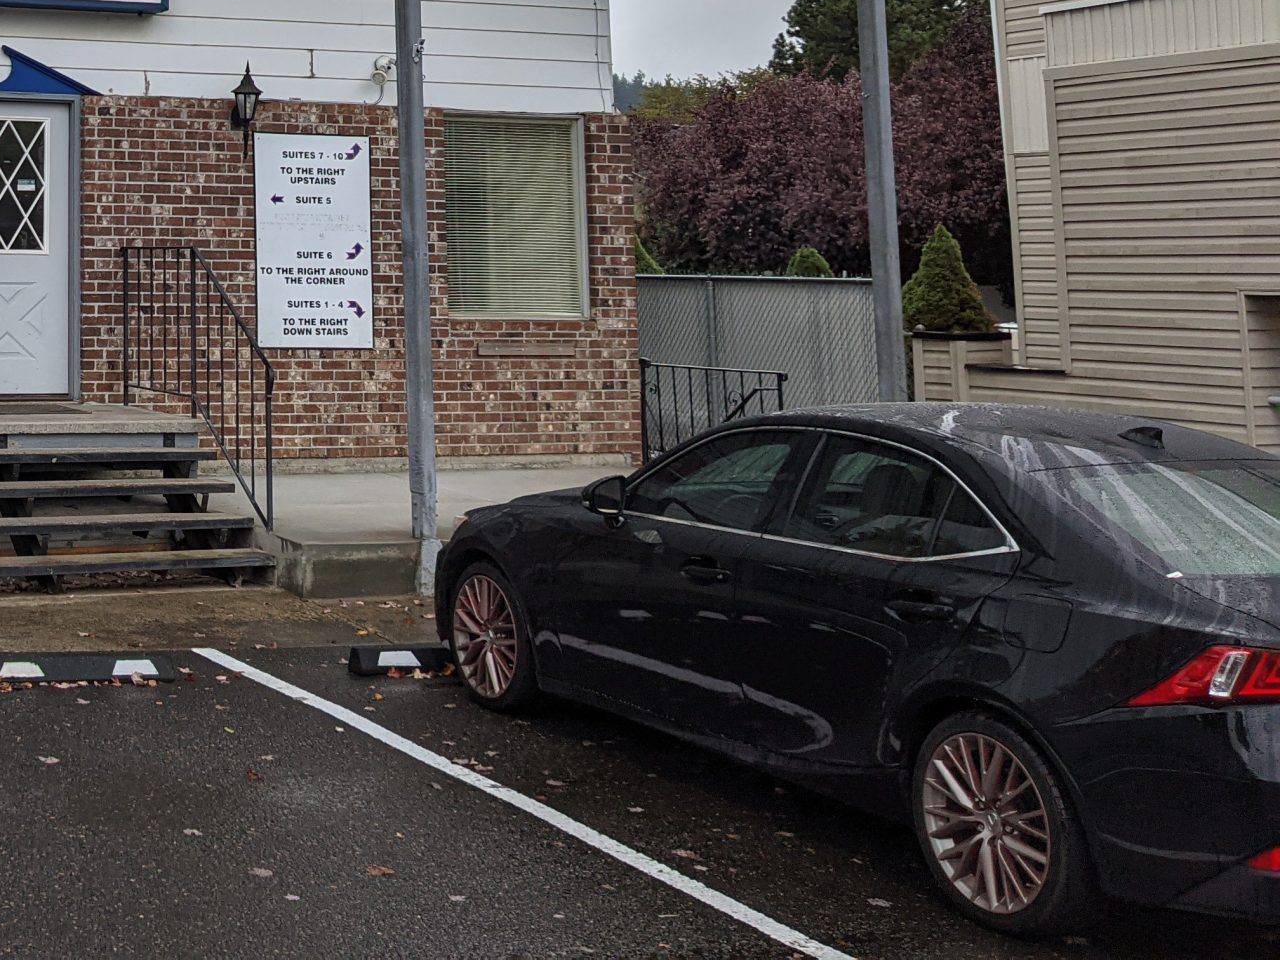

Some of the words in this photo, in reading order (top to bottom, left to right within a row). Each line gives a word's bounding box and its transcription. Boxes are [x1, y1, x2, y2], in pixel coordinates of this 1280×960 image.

[282, 150, 316, 160] SUITES
[318, 152, 324, 160] 7
[333, 152, 344, 161] 10
[279, 166, 293, 175] TO
[295, 167, 314, 175] THE
[316, 167, 346, 176] RIGHT
[290, 176, 337, 186] UPSTAIRS
[295, 195, 323, 205] SUITE
[326, 196, 332, 205] 5
[296, 250, 324, 260] SUITE
[326, 251, 333, 260] 6
[260, 266, 273, 275] TO
[275, 267, 295, 275] THE
[297, 267, 327, 276] RIGHT
[328, 267, 369, 276] AROUND
[284, 276, 303, 285] THE
[305, 276, 345, 285] CORNER
[287, 300, 321, 309] SUITES
[337, 301, 344, 309] 4
[282, 317, 296, 326] TO
[297, 318, 317, 326] THE
[319, 318, 349, 326] RIGHT
[283, 327, 312, 336] DOWN
[314, 327, 349, 336] STAIRS
